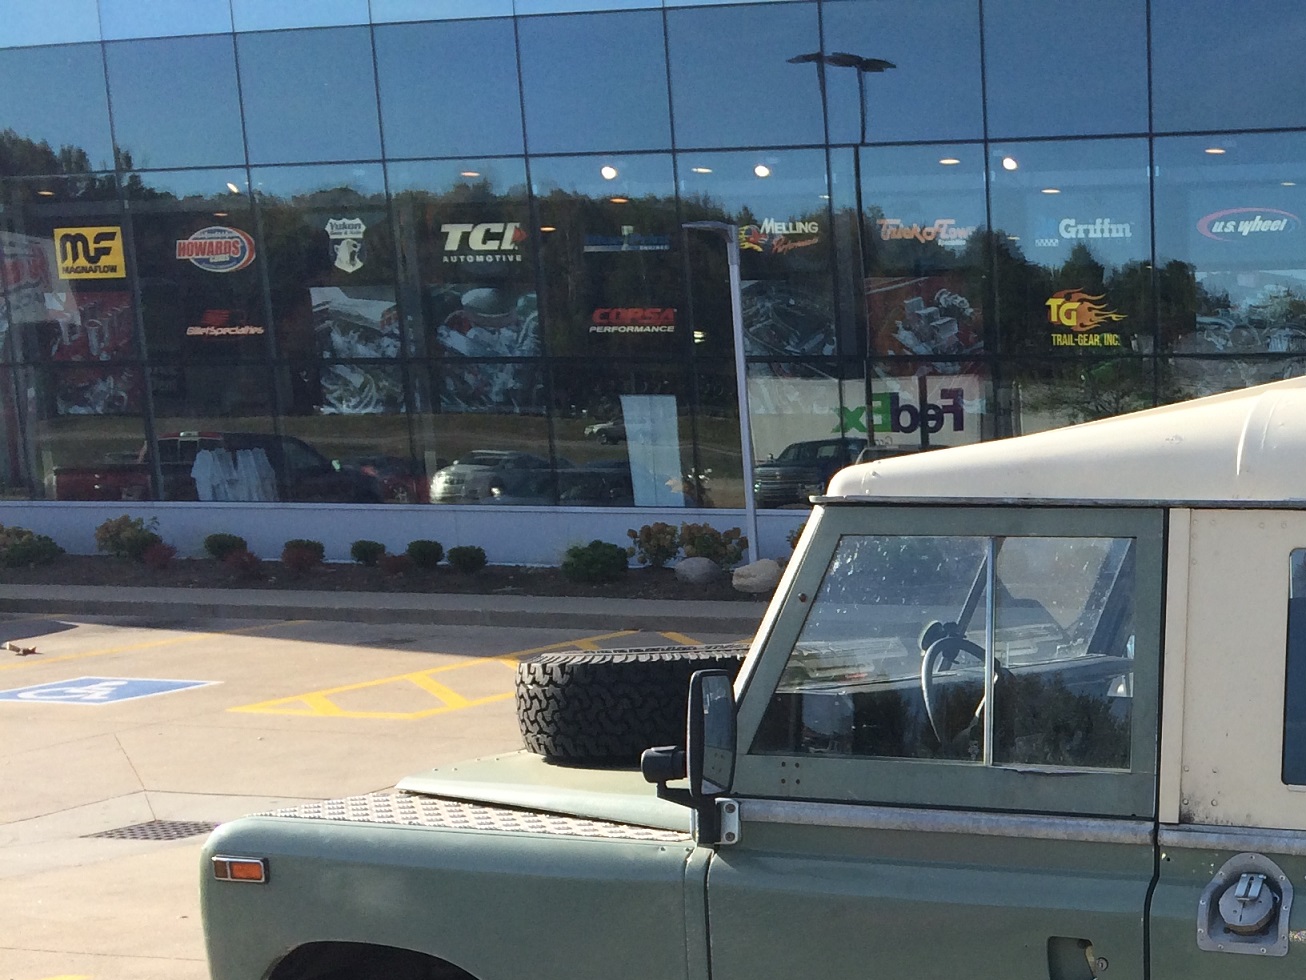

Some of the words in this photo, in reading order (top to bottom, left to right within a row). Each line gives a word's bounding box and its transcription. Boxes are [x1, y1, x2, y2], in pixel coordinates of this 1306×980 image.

[760, 218, 819, 234] MELLING
[1058, 218, 1132, 239] Griffin
[1238, 215, 1288, 235] wheel
[440, 222, 521, 251] TCI
[177, 240, 241, 258] HOWARDS
[442, 254, 522, 263] AUTOMOTIVE
[62, 265, 118, 275] MAGNAFLOW
[592, 307, 675, 326] CORSA
[1045, 298, 1081, 327] TG
[1103, 333, 1121, 346] INC.
